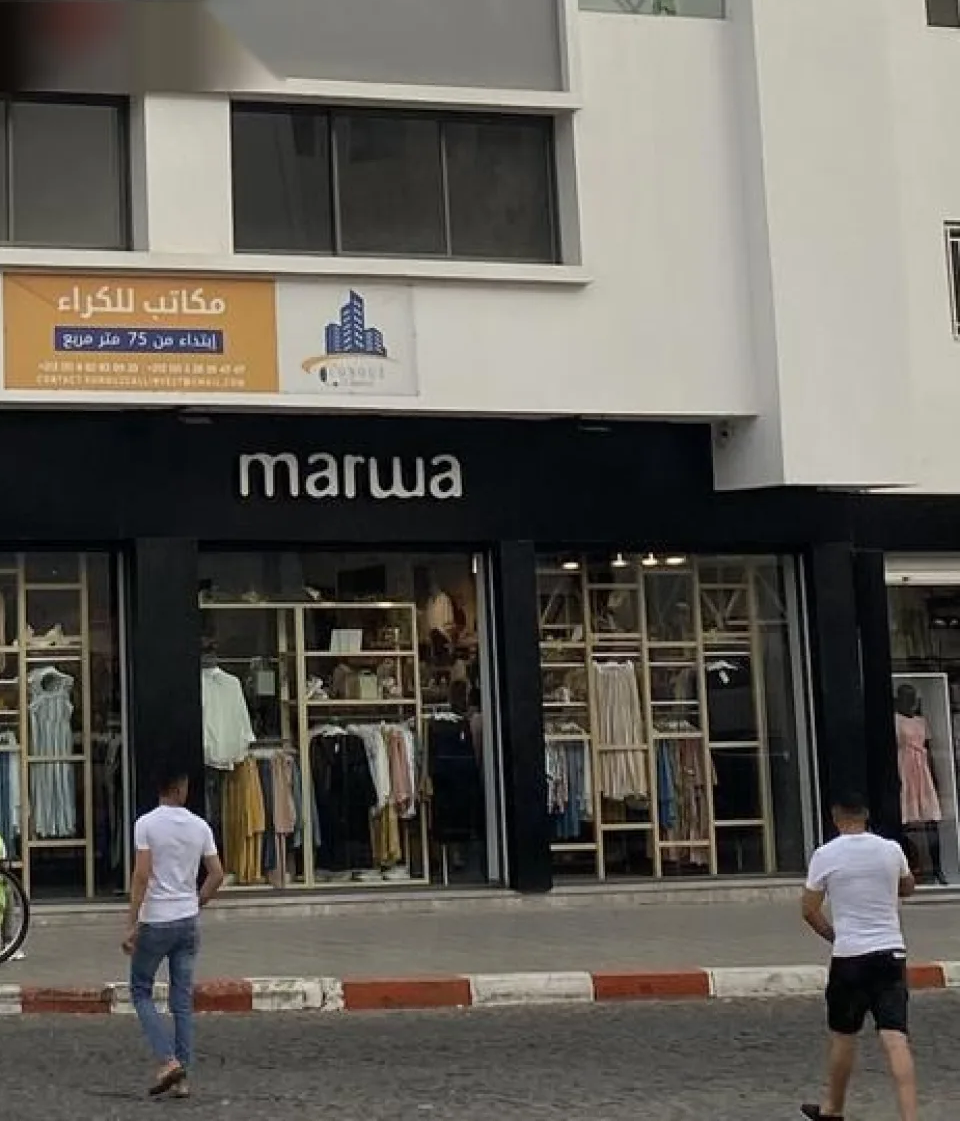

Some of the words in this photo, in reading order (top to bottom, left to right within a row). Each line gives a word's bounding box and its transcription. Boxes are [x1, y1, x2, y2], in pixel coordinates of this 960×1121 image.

[57, 284, 135, 319] للكراء
[143, 287, 226, 321] مكاتب
[62, 332, 93, 349] مربع
[97, 332, 121, 348] متر
[127, 331, 147, 346] 75
[152, 333, 174, 350] من
[239, 452, 463, 499] marwa
